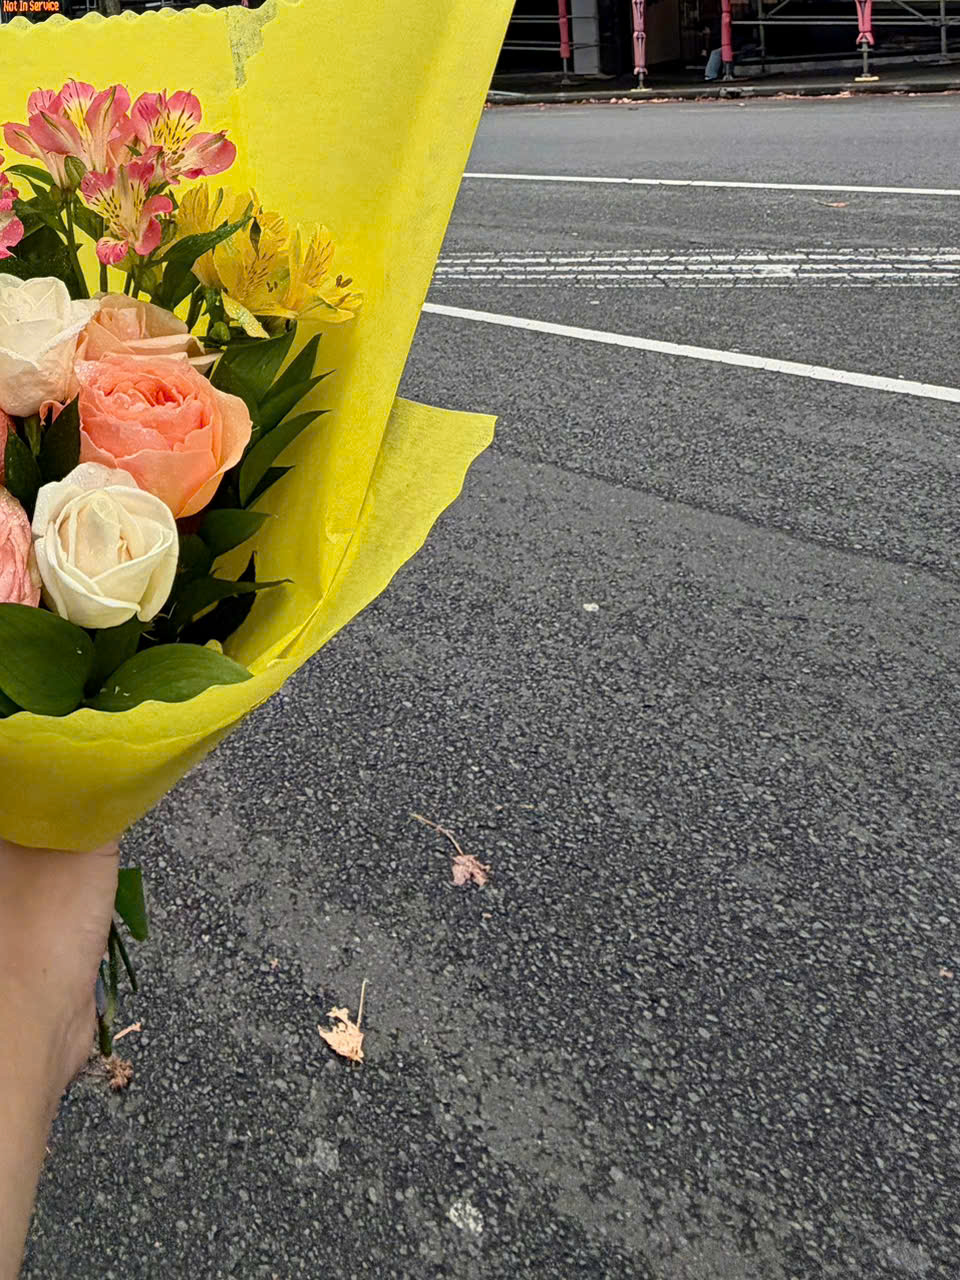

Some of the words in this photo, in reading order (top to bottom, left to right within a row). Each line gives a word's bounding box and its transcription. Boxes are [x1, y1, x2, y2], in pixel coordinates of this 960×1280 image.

[3, 0, 18, 12] Not
[19, 0, 28, 12] In
[29, 0, 60, 12] Service
